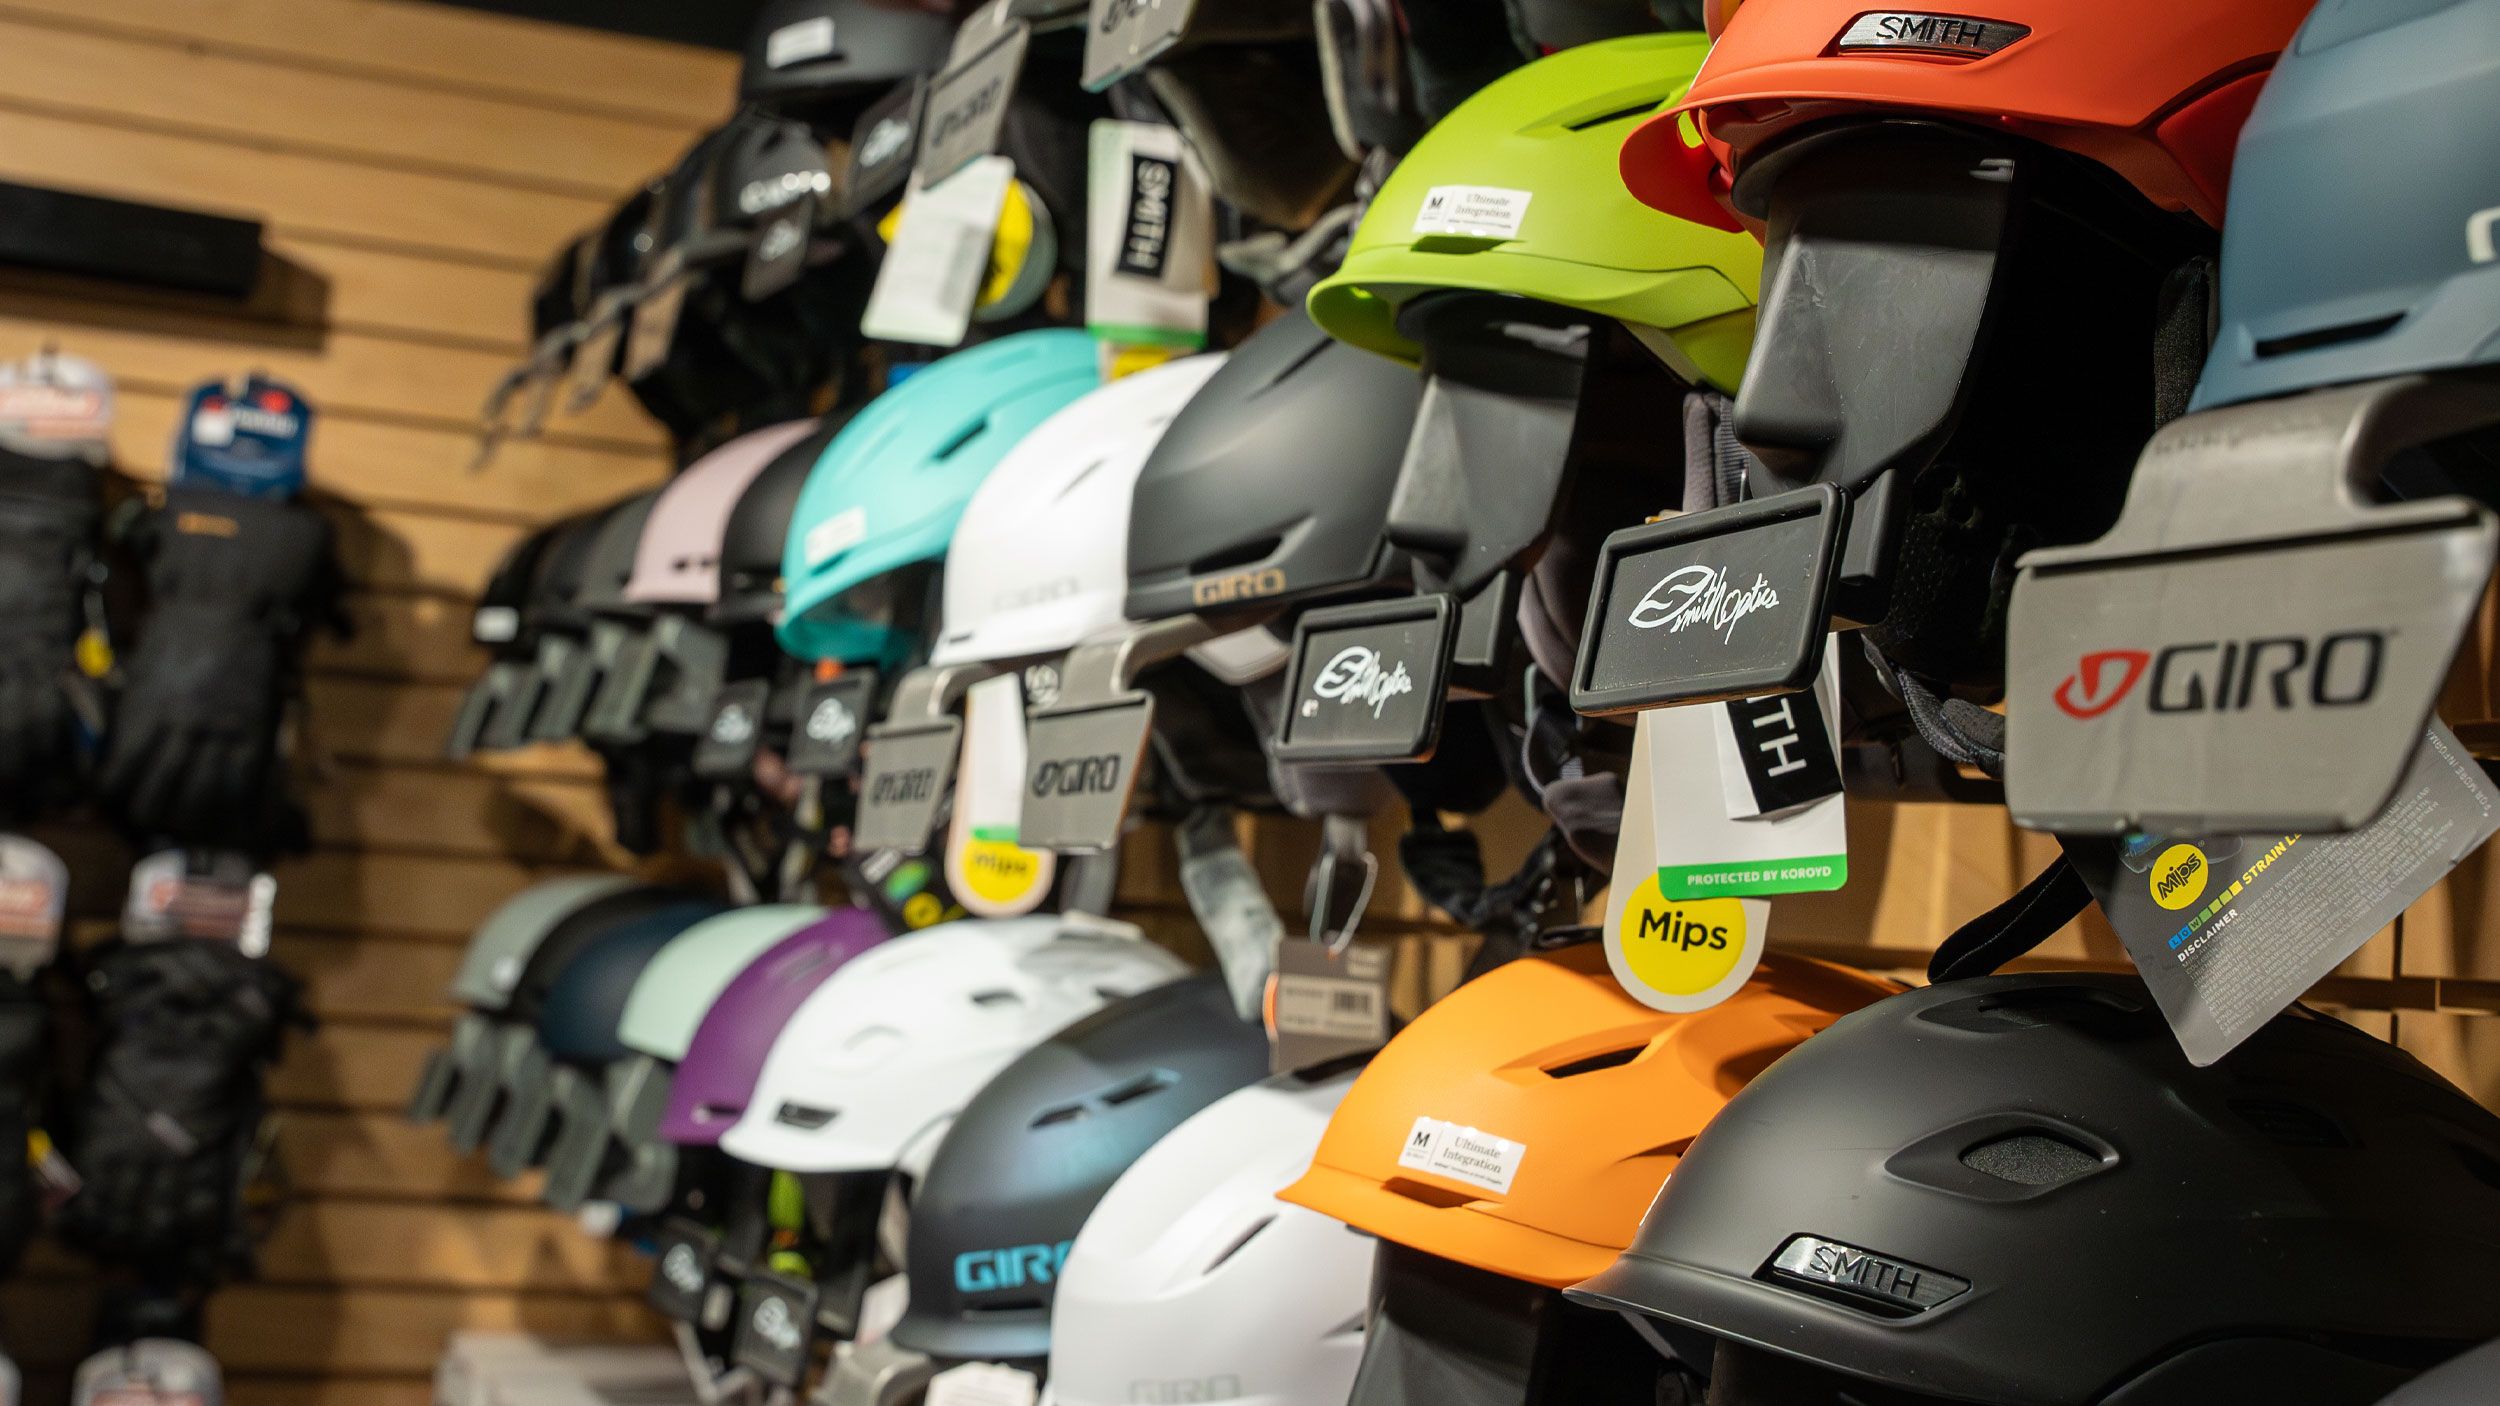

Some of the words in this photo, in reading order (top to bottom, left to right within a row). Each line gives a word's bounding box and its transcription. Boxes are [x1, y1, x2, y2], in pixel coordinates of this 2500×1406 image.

[1876, 16, 1985, 48] SMITH
[1429, 196, 1444, 209] M
[1193, 568, 1286, 607] GIRO
[2146, 630, 2387, 714] GIRO
[1747, 696, 1807, 777] TH
[1058, 754, 1121, 796] GIRO
[1687, 871, 1760, 886] PROTECTED
[1763, 870, 1778, 881] BY
[1780, 866, 1831, 880] KOROYD
[2157, 853, 2202, 901] Mips
[2242, 841, 2287, 885] STRAIN
[1638, 908, 1729, 952] Mips
[2177, 908, 2239, 963] DISCLAIMER
[1413, 1131, 1430, 1148] M
[1455, 1136, 1502, 1158] Ultimate
[1443, 1148, 1502, 1174] Integration
[1810, 1245, 1922, 1299] SMITH
